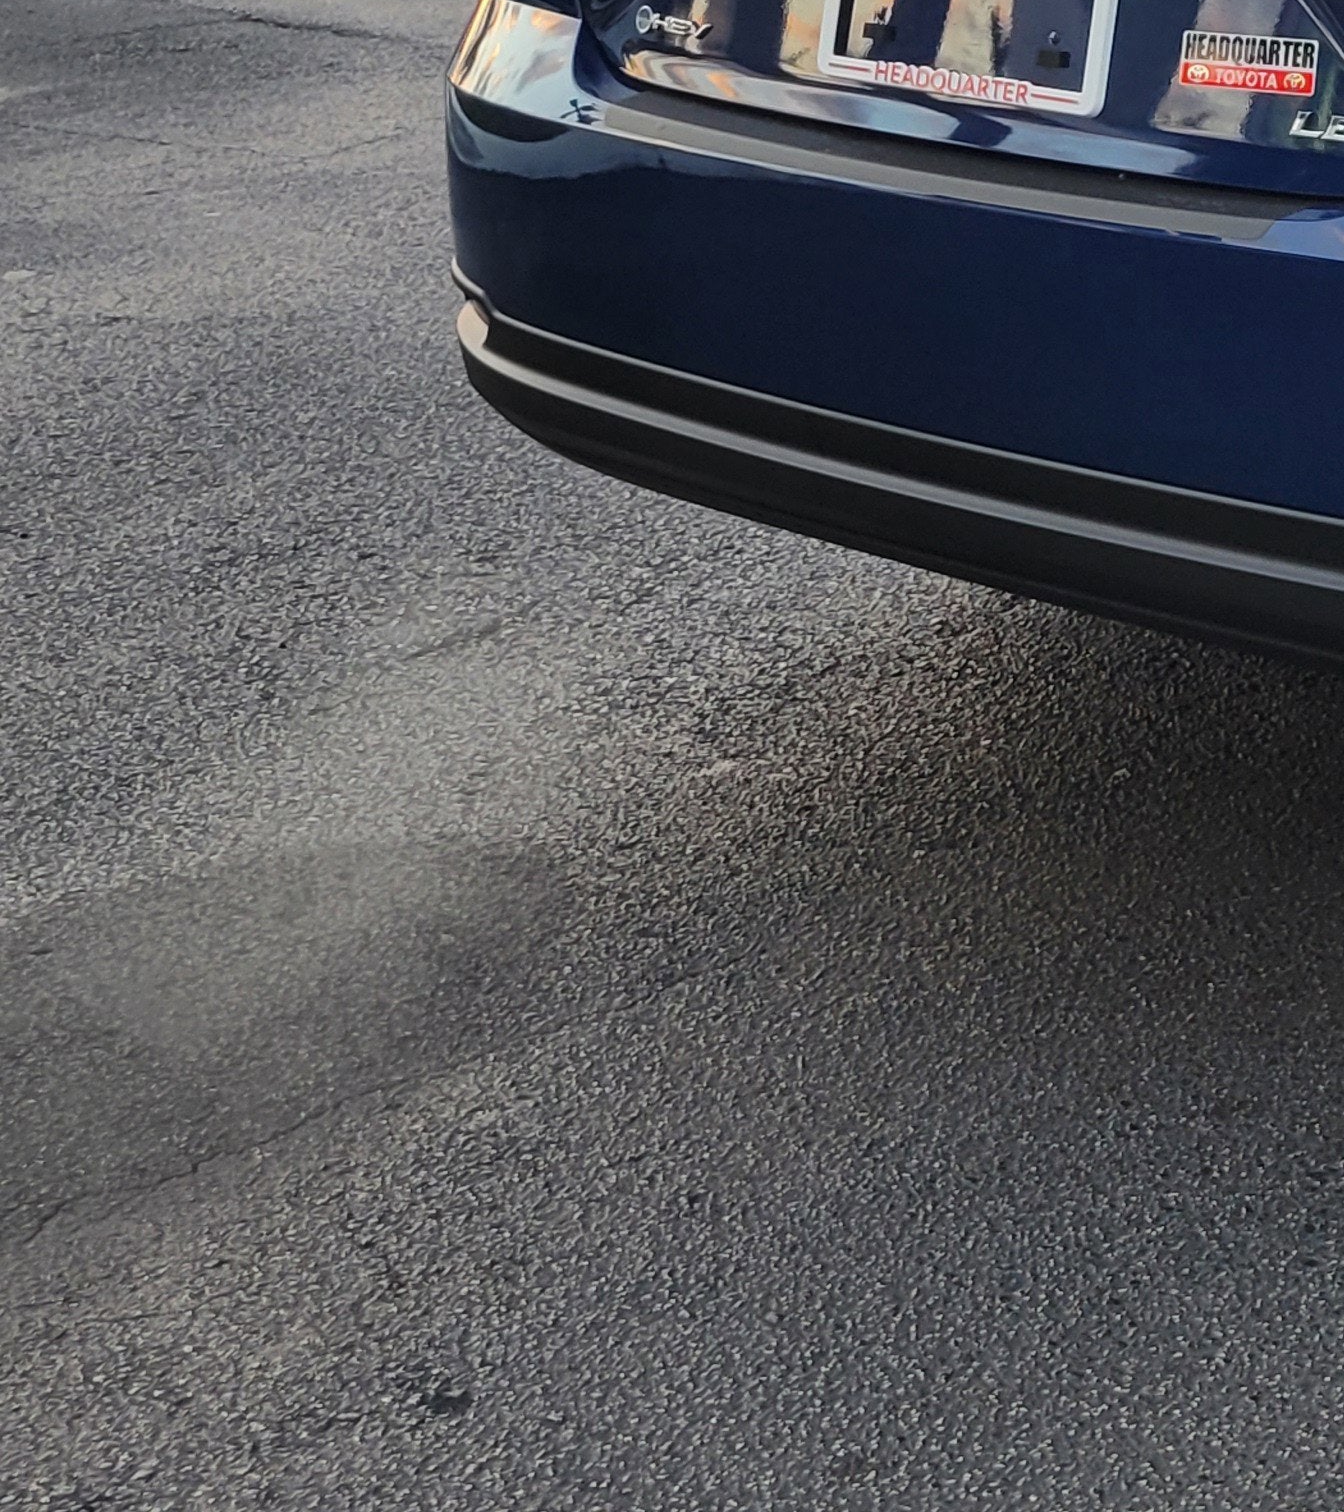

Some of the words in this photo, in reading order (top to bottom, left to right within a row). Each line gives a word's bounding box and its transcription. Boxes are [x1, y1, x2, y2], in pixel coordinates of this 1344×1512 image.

[1184, 32, 1316, 69] HEADQUARTER
[874, 60, 1029, 104] HEADQUARTER
[1214, 68, 1279, 90] TOYOTA
